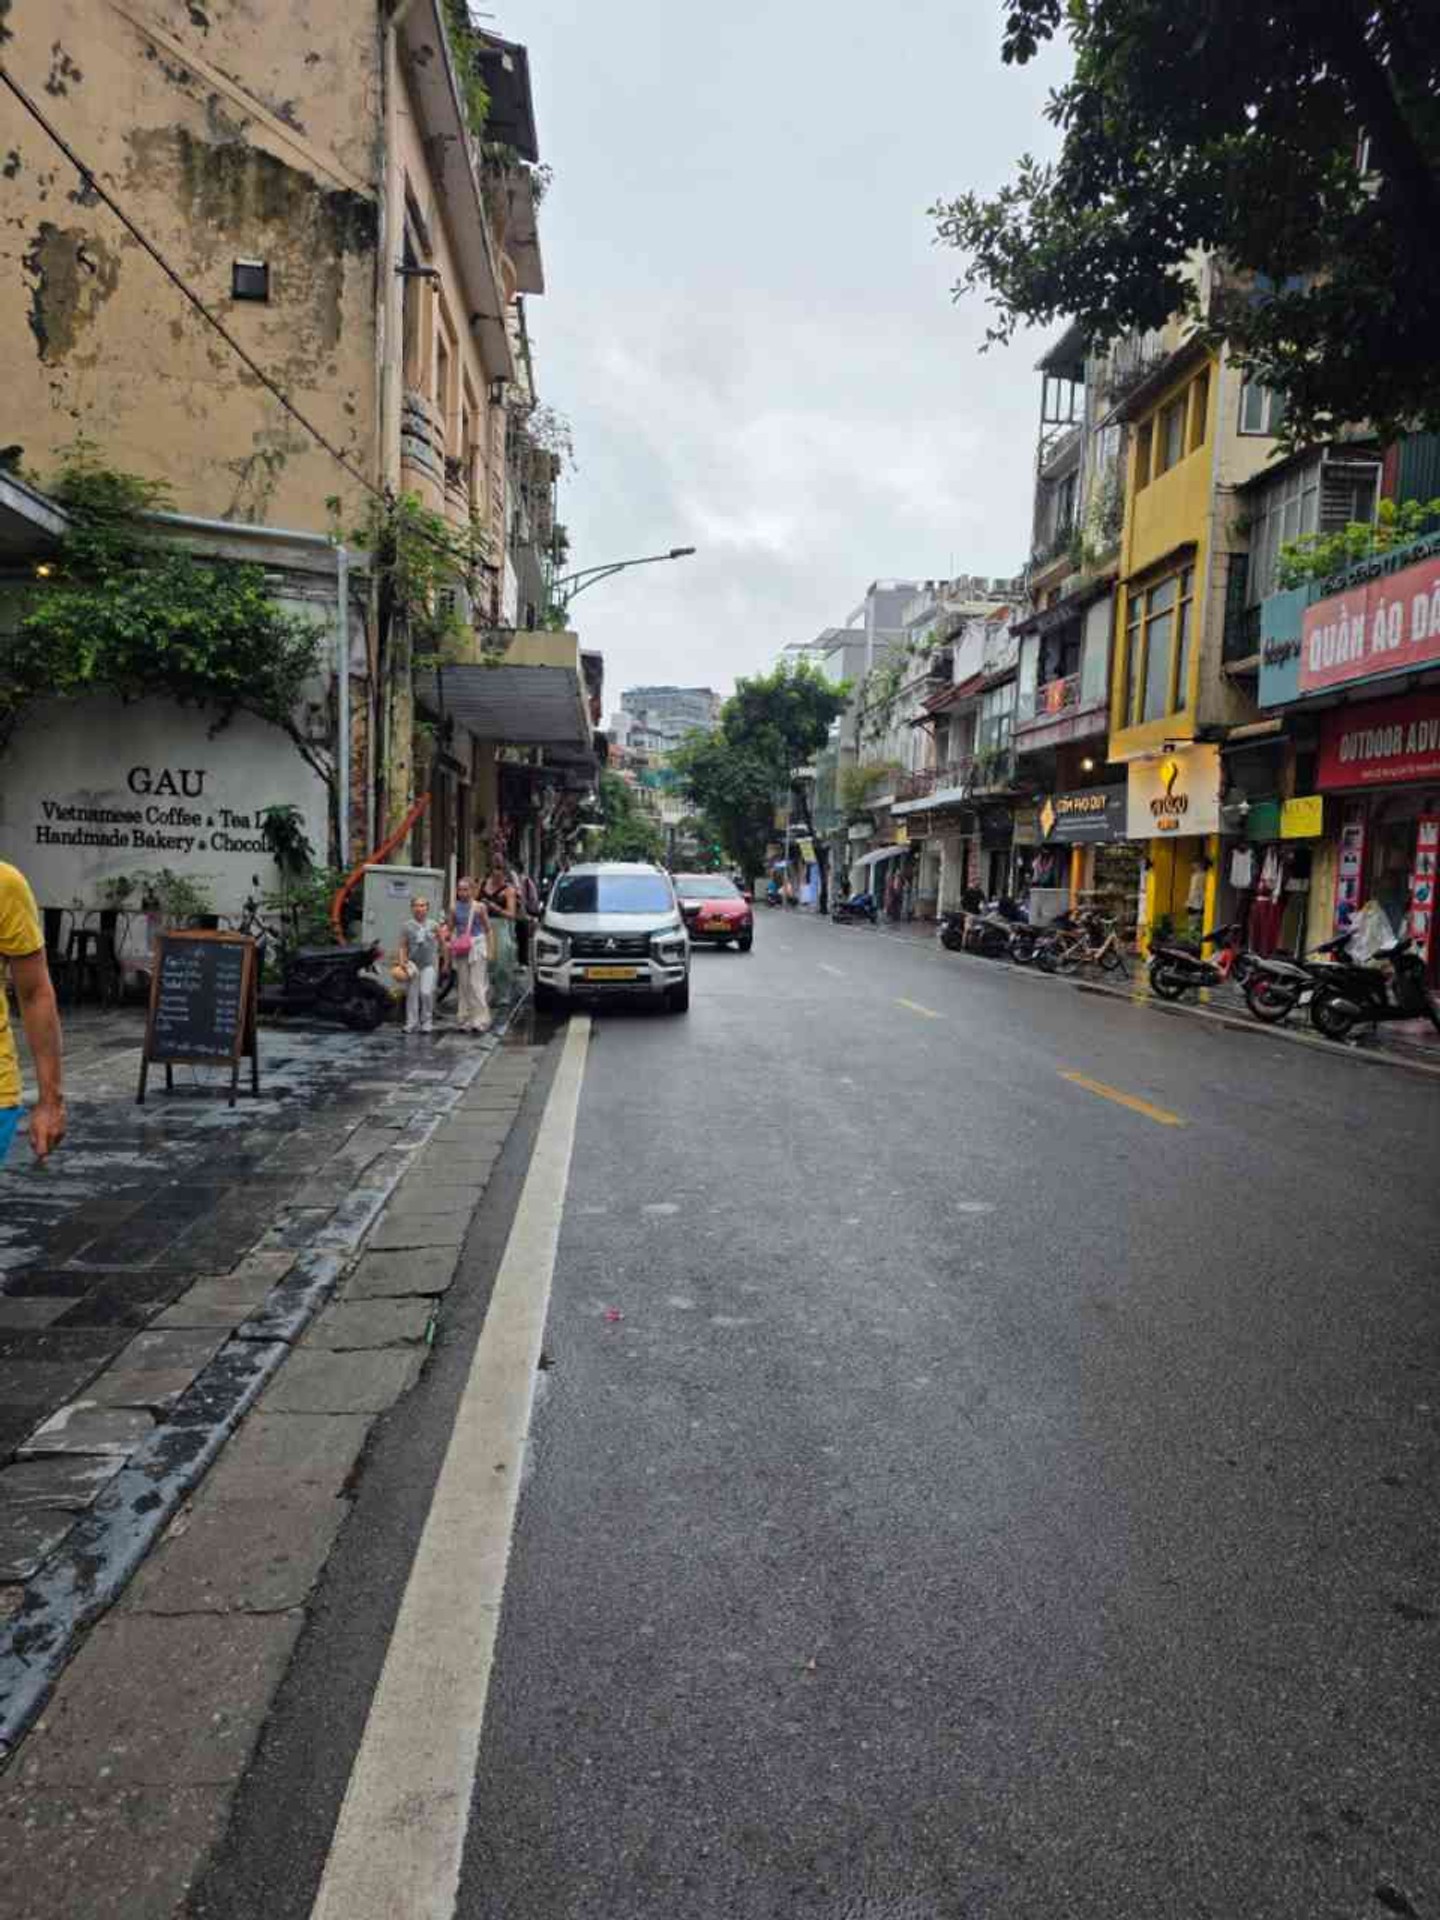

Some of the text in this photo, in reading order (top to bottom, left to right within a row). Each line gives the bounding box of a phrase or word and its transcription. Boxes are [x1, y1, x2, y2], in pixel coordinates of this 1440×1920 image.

[1372, 597, 1404, 652] ÁO
[1339, 719, 1440, 764] OUTDOOR ADV
[127, 767, 207, 798] GAU
[41, 801, 142, 824] Vietnamese
[146, 805, 202, 828] Coffee
[219, 809, 250, 829] Tea
[36, 825, 129, 848] Handmade
[132, 829, 195, 854] Bakery
